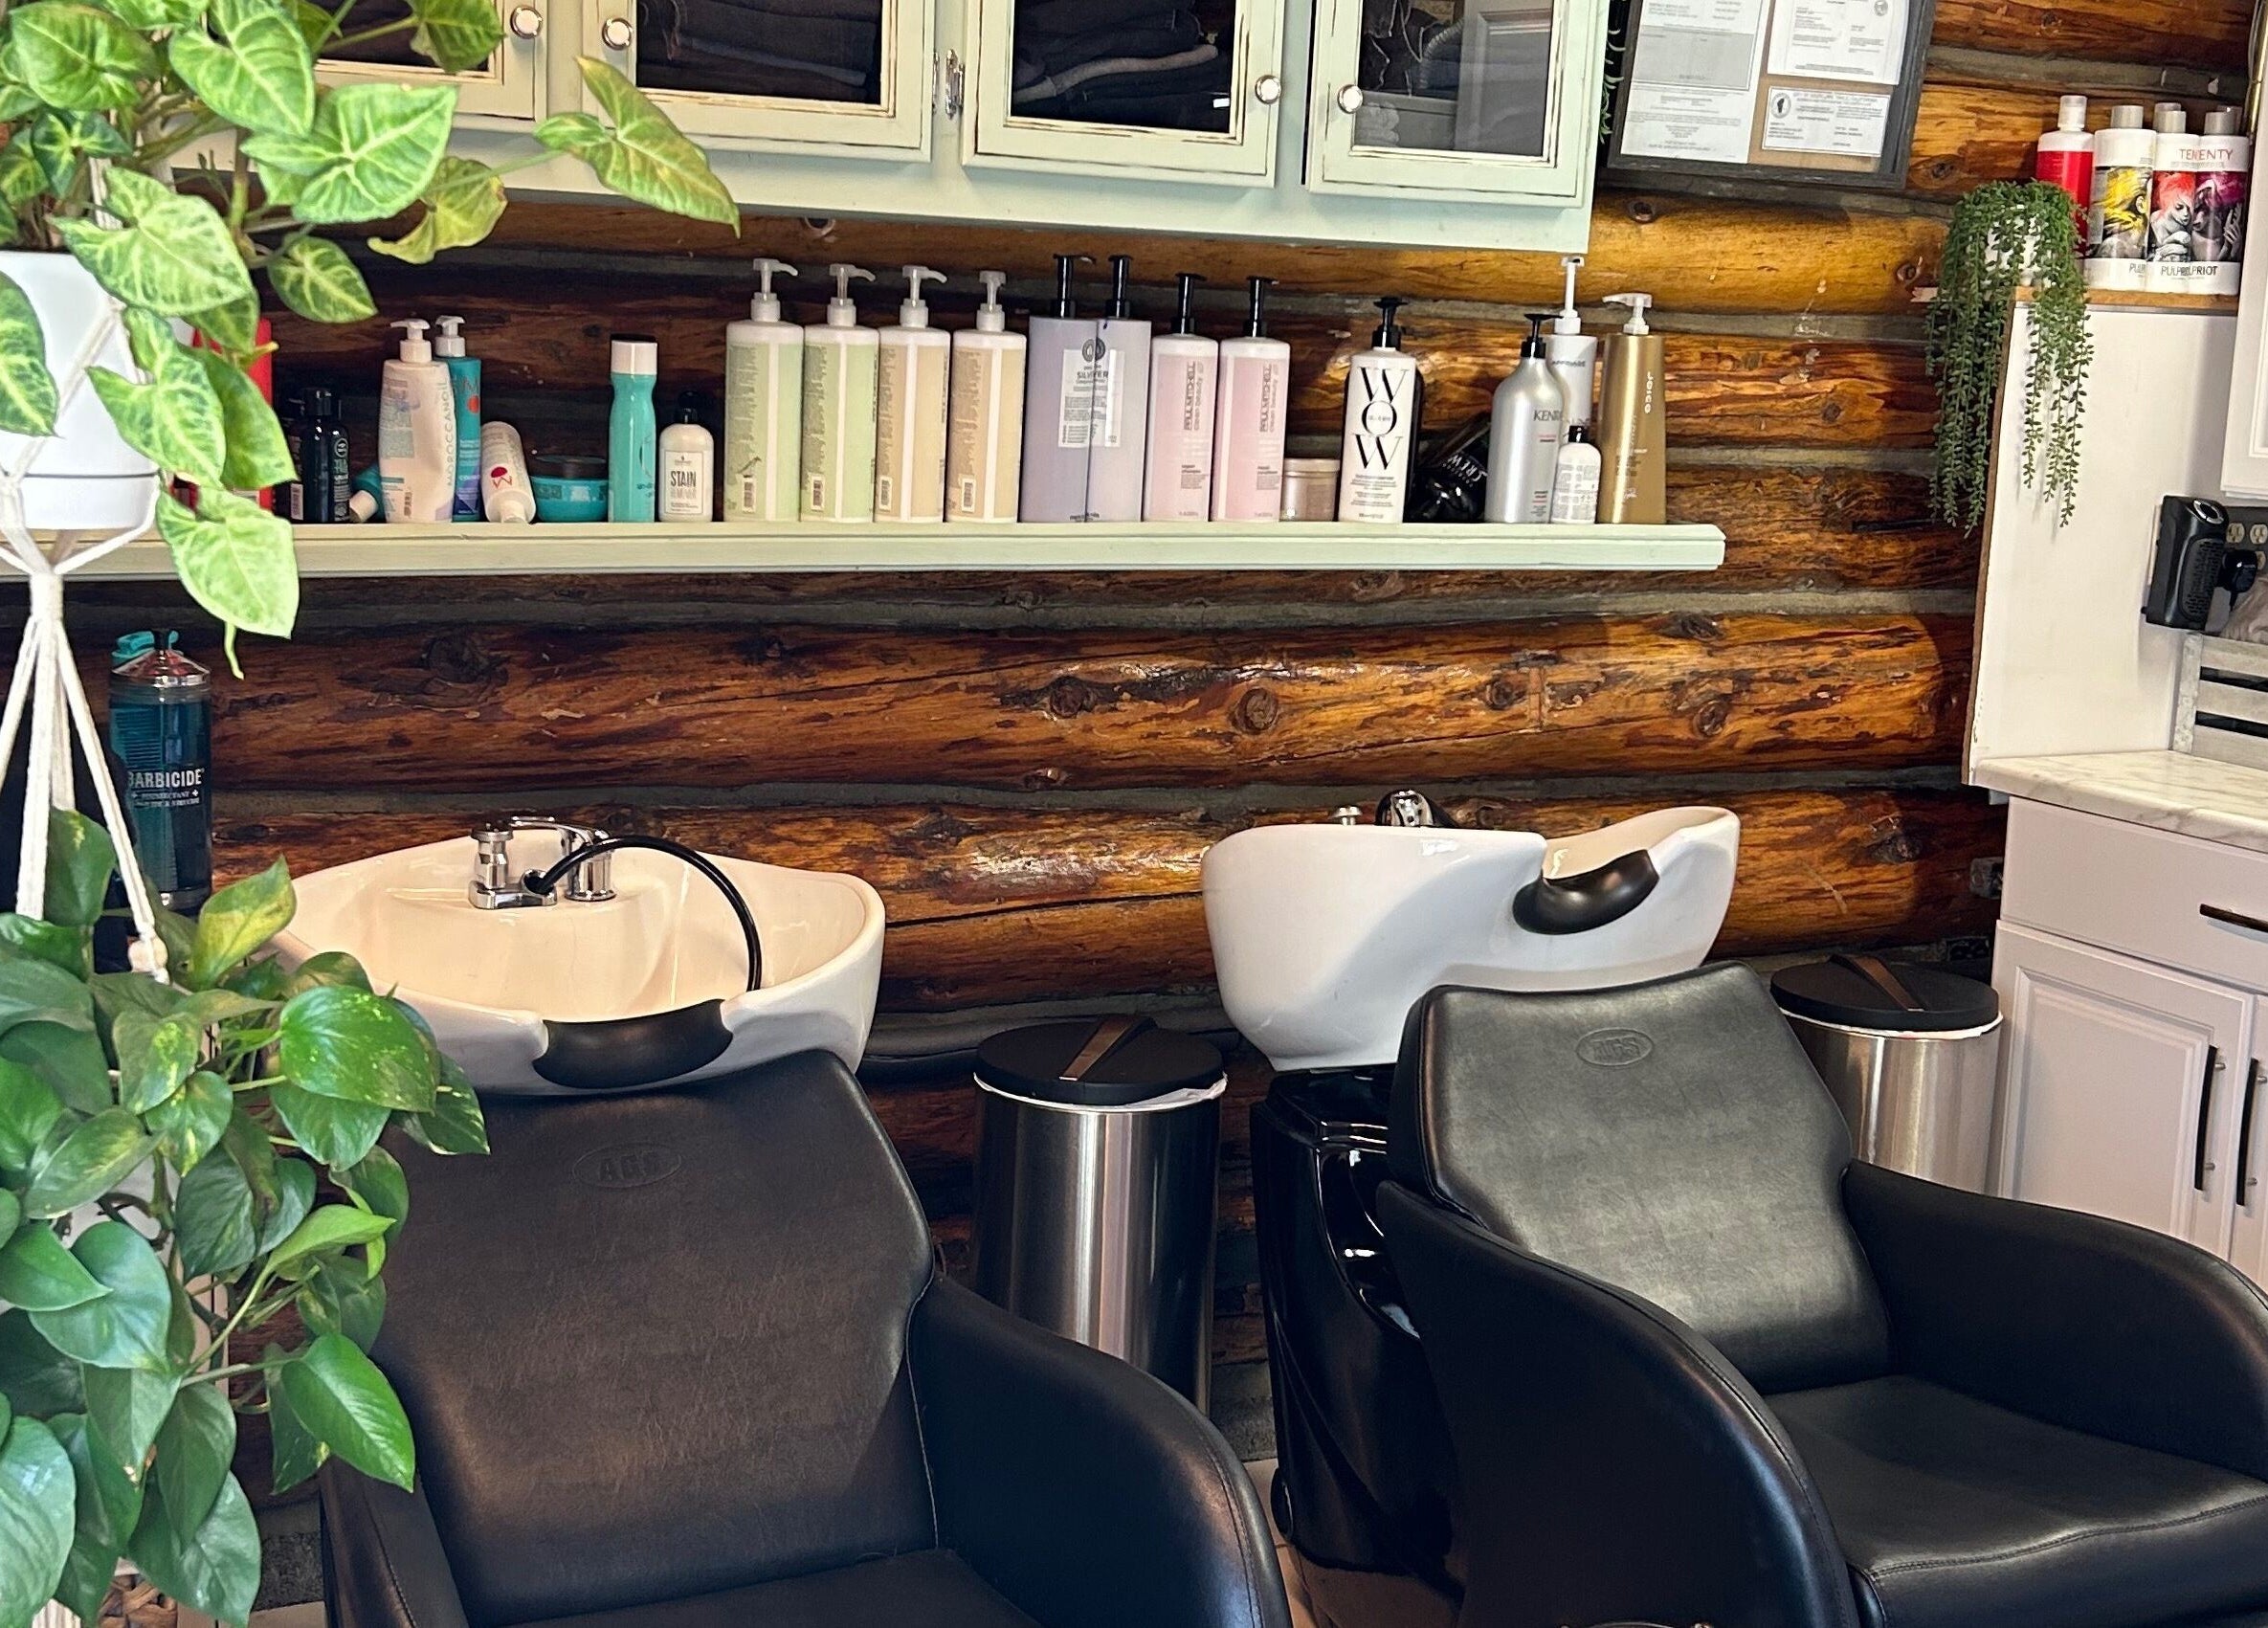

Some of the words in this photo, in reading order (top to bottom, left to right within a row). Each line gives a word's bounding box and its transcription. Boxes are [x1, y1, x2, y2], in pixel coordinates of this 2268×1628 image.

[1644, 371, 1654, 413] JOICO
[436, 381, 455, 486] MOROCCANOIL
[671, 470, 697, 488] STAIN
